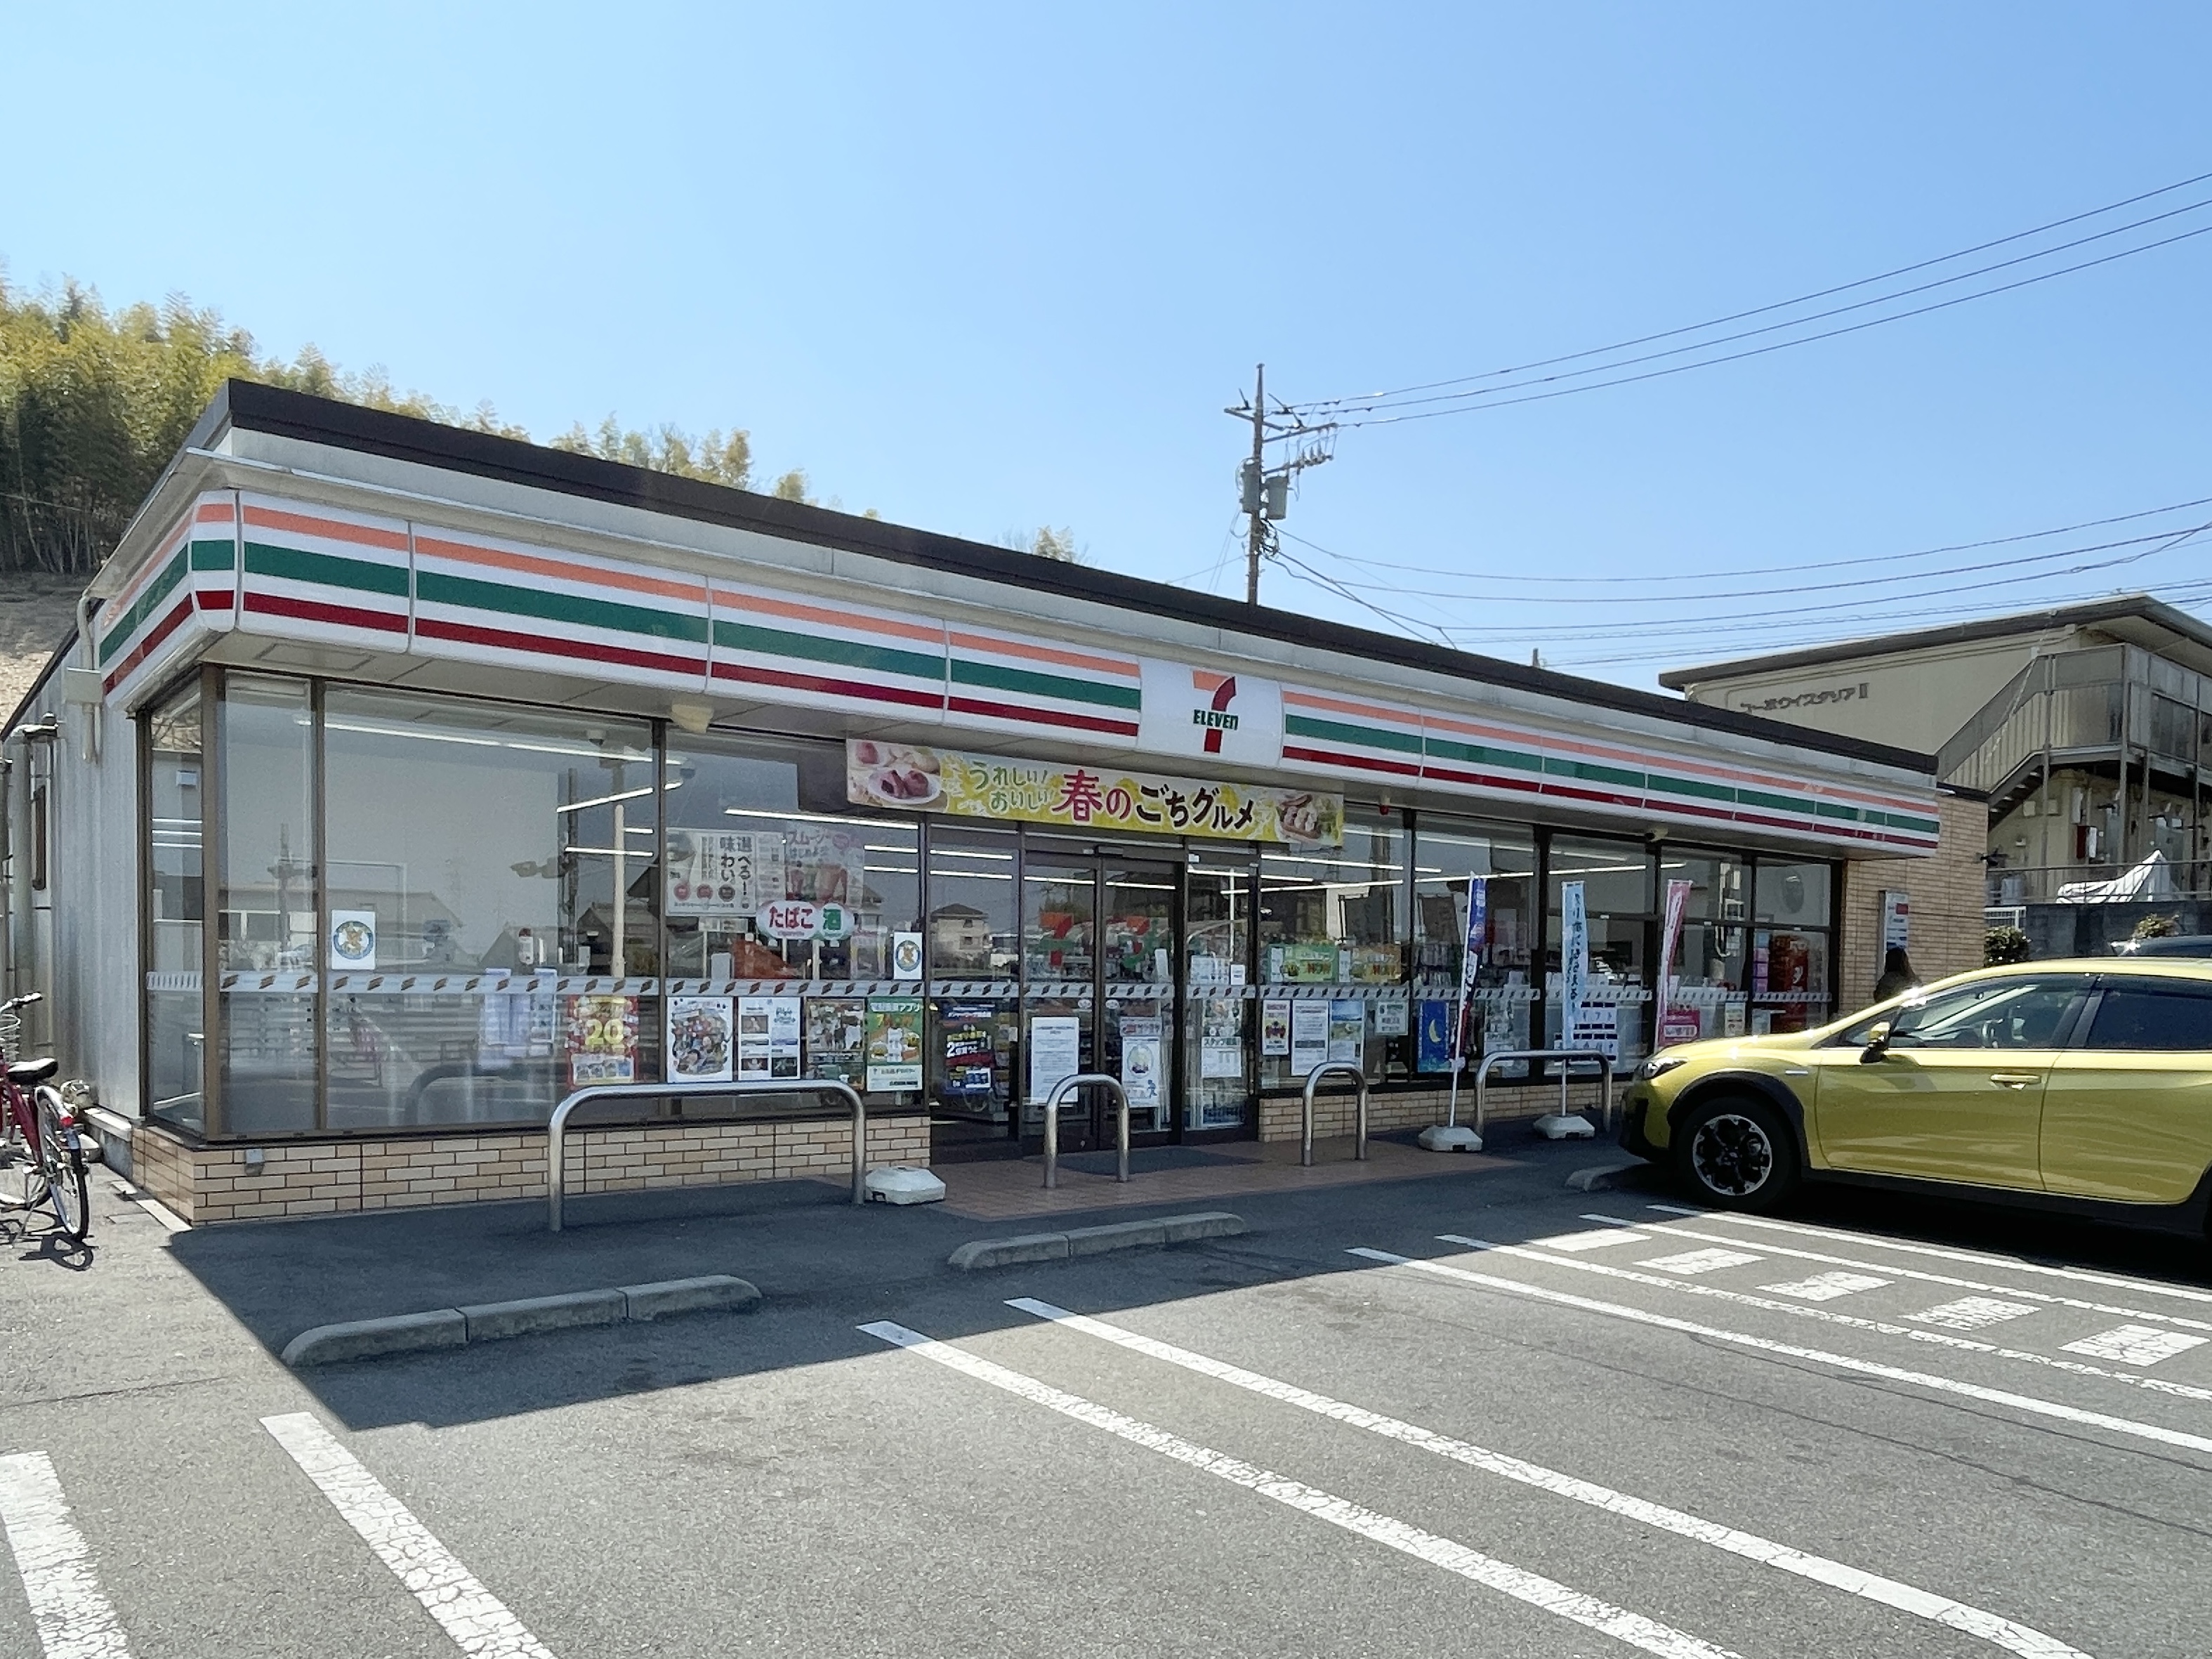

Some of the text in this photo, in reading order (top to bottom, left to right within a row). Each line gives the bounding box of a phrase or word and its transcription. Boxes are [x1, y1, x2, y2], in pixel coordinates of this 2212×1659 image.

[1052, 769, 1254, 830] 春のごちグルメ
[769, 906, 814, 929] たばこ
[585, 1018, 624, 1045] 20
